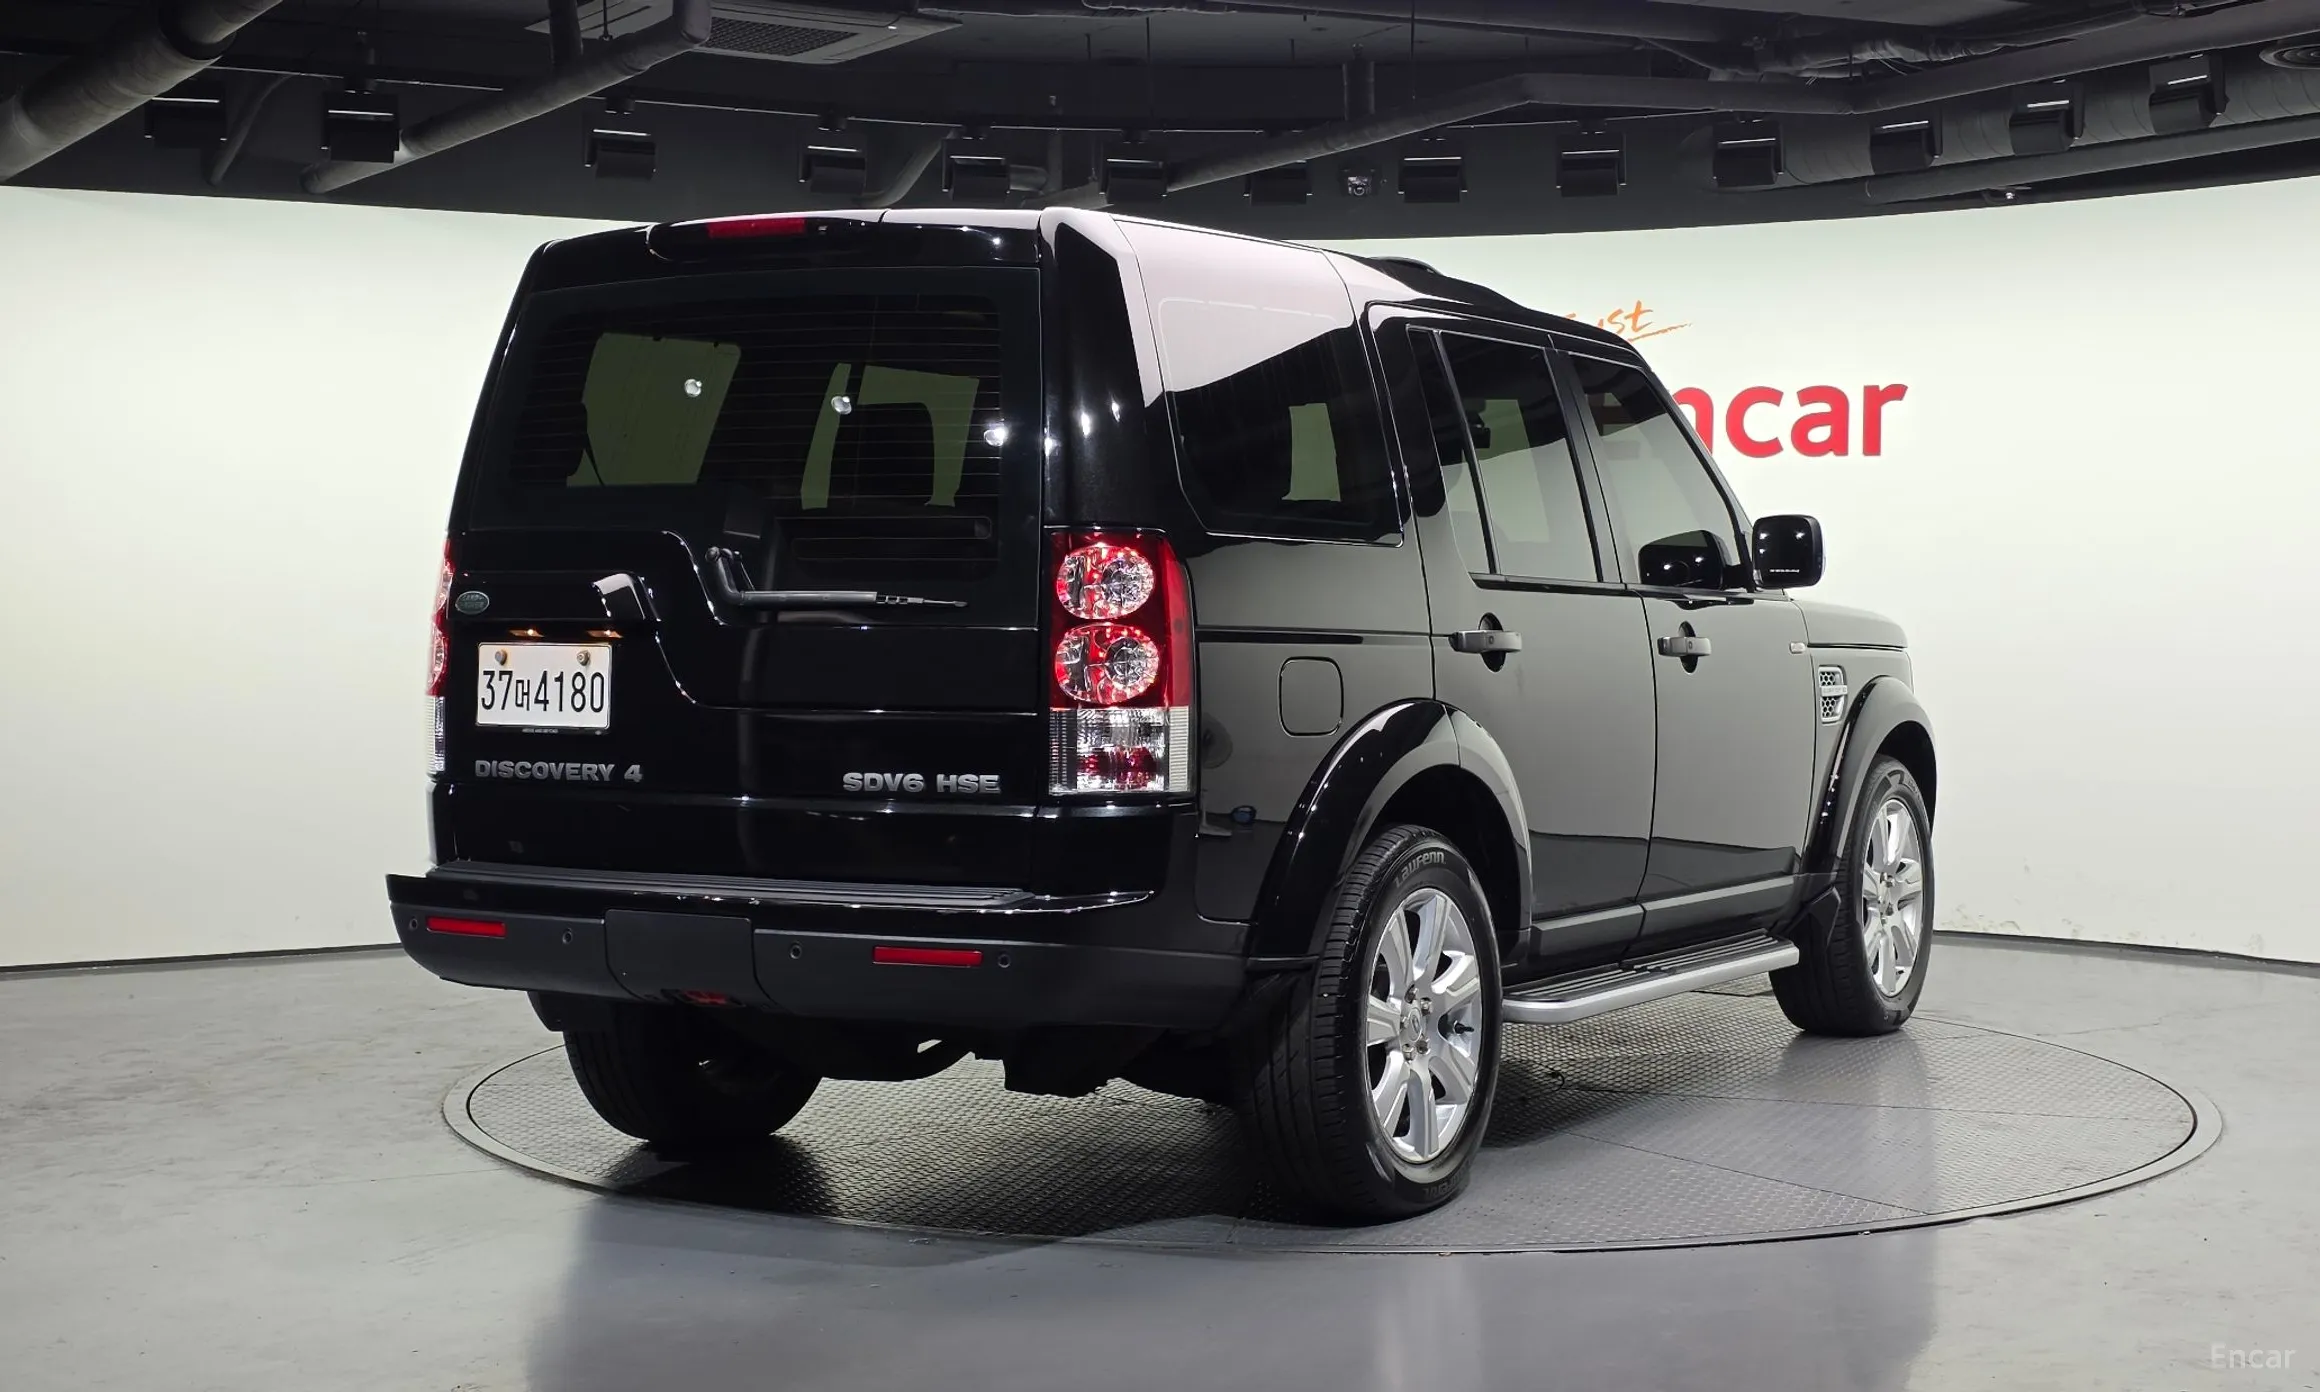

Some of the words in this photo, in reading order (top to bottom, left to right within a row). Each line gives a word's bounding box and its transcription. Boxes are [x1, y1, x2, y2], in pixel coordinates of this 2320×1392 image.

[1671, 384, 1908, 458] ncar
[481, 670, 605, 713] 37머4180
[475, 760, 614, 781] DISCOVERY
[624, 764, 643, 782] 4
[843, 772, 925, 793] SDV6
[936, 774, 1000, 793] HSE
